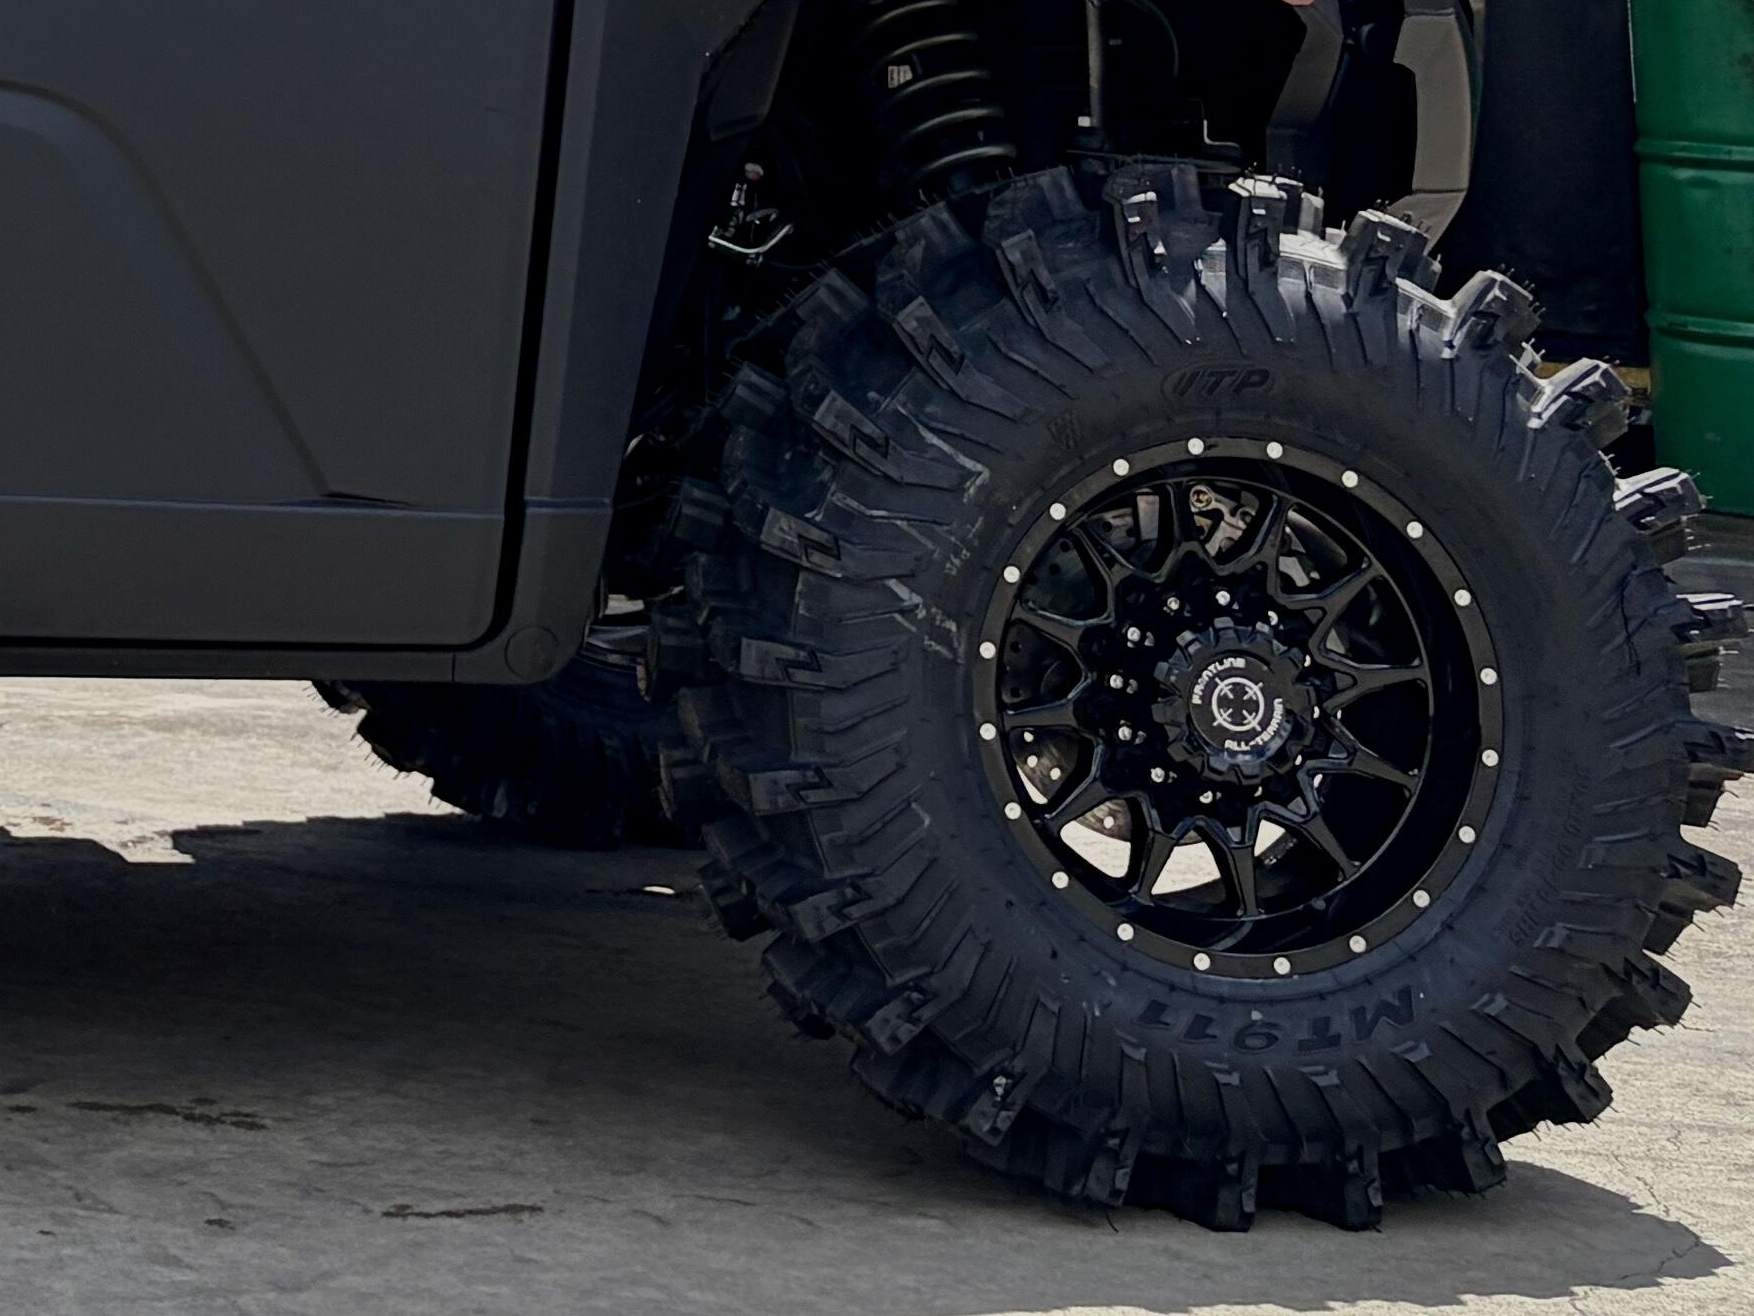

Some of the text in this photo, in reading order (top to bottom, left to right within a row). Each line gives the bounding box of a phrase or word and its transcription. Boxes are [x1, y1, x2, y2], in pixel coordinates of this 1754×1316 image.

[1172, 367, 1271, 397] ITP
[1192, 657, 1246, 704] FRONTLINE
[1224, 698, 1283, 751] ALL-TERRAIN
